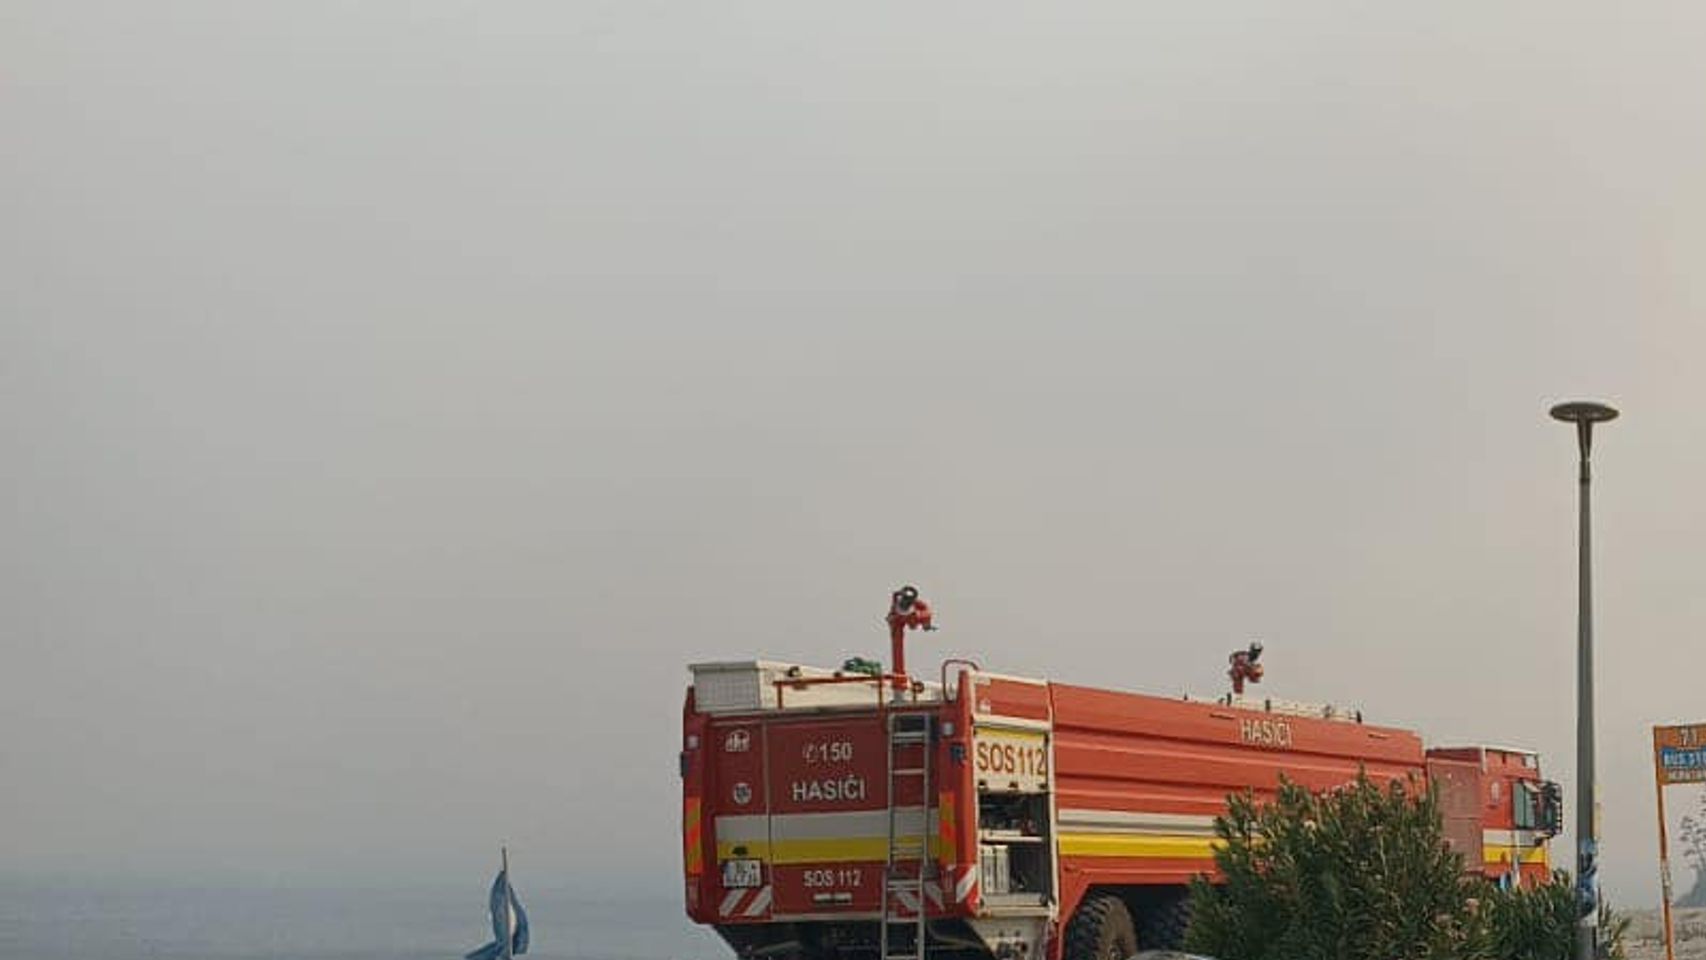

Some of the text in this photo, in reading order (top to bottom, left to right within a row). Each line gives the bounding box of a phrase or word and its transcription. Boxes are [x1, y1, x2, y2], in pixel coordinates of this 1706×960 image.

[1241, 717, 1292, 747] HASIČI
[819, 742, 852, 762] 150
[792, 774, 865, 801] HASIČI
[803, 869, 861, 887] SOS 112
